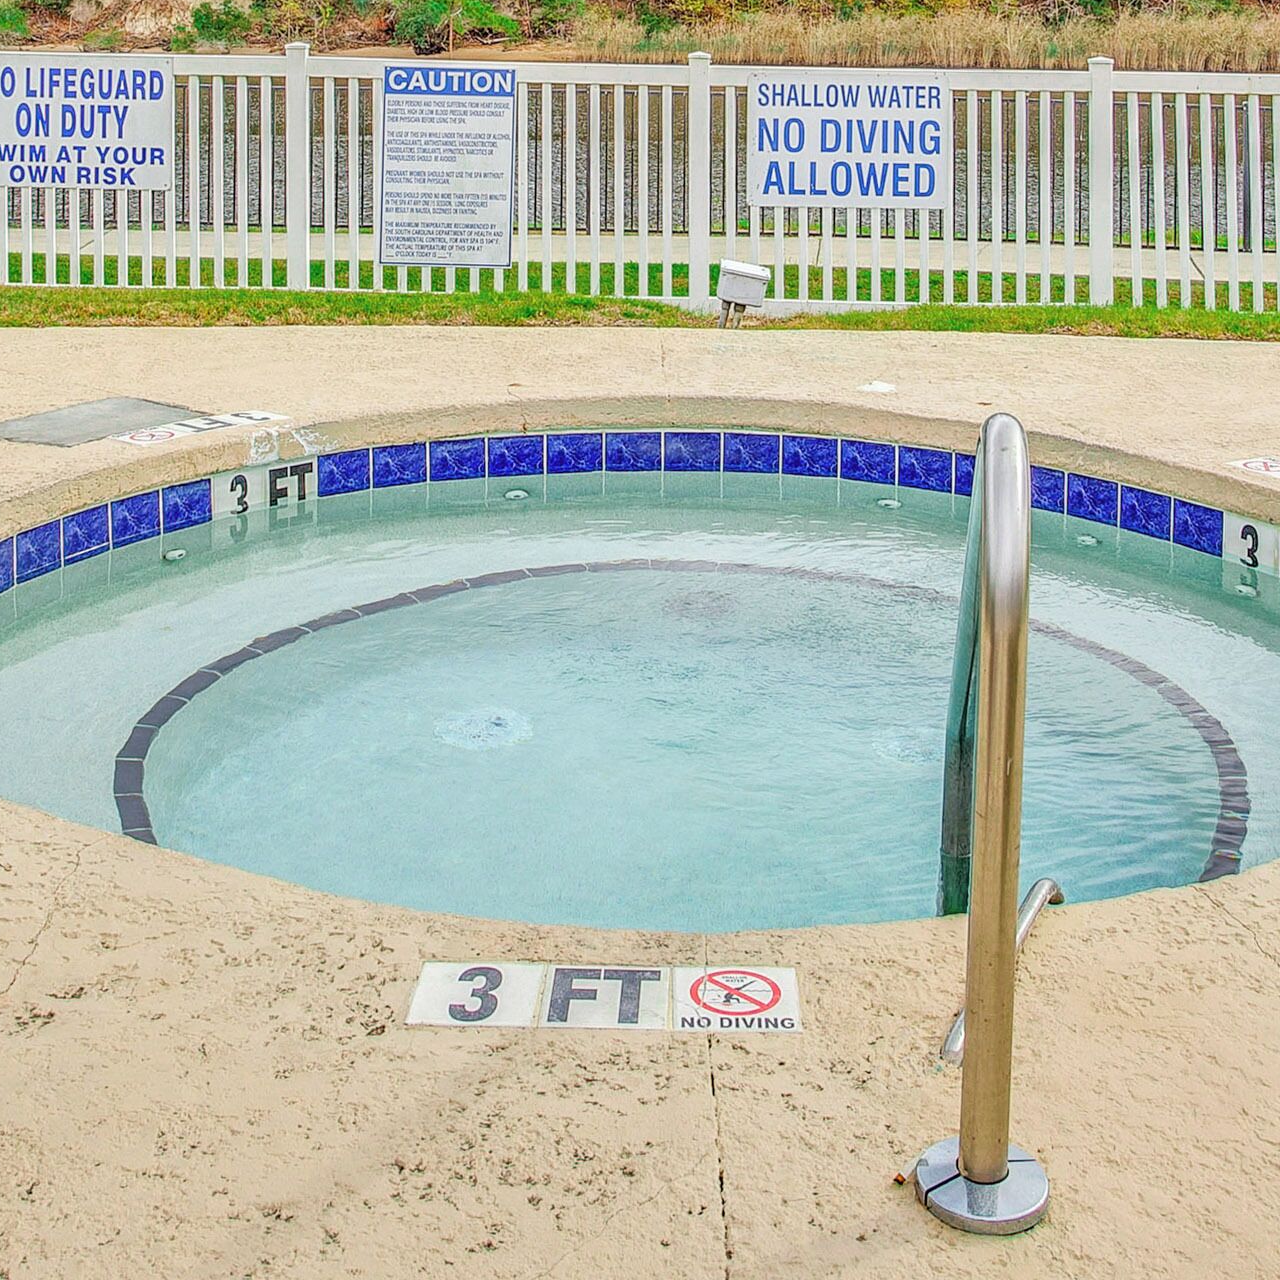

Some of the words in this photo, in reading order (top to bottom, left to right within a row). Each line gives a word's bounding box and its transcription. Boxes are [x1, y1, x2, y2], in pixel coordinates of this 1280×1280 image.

[25, 67, 165, 101] LIFEGUARD
[388, 70, 512, 93] CAUTION
[758, 83, 860, 108] SHALLOW
[868, 85, 941, 109] WATER
[15, 103, 49, 137] ON
[61, 104, 129, 139] DUTY
[758, 118, 805, 152] NO
[820, 119, 941, 155] DIVING
[56, 145, 88, 165] AT
[94, 145, 165, 166] YOUR
[9, 165, 66, 185] OWN
[77, 166, 136, 185] RISK
[763, 161, 936, 197] ALLOWED
[175, 417, 238, 433] FT
[230, 474, 249, 515] 3
[269, 462, 313, 507] FT
[1239, 524, 1259, 569] 3
[447, 966, 503, 1022] 3
[547, 967, 661, 1024] FT
[680, 1017, 712, 1029] NO
[720, 1017, 795, 1029] DIVING
